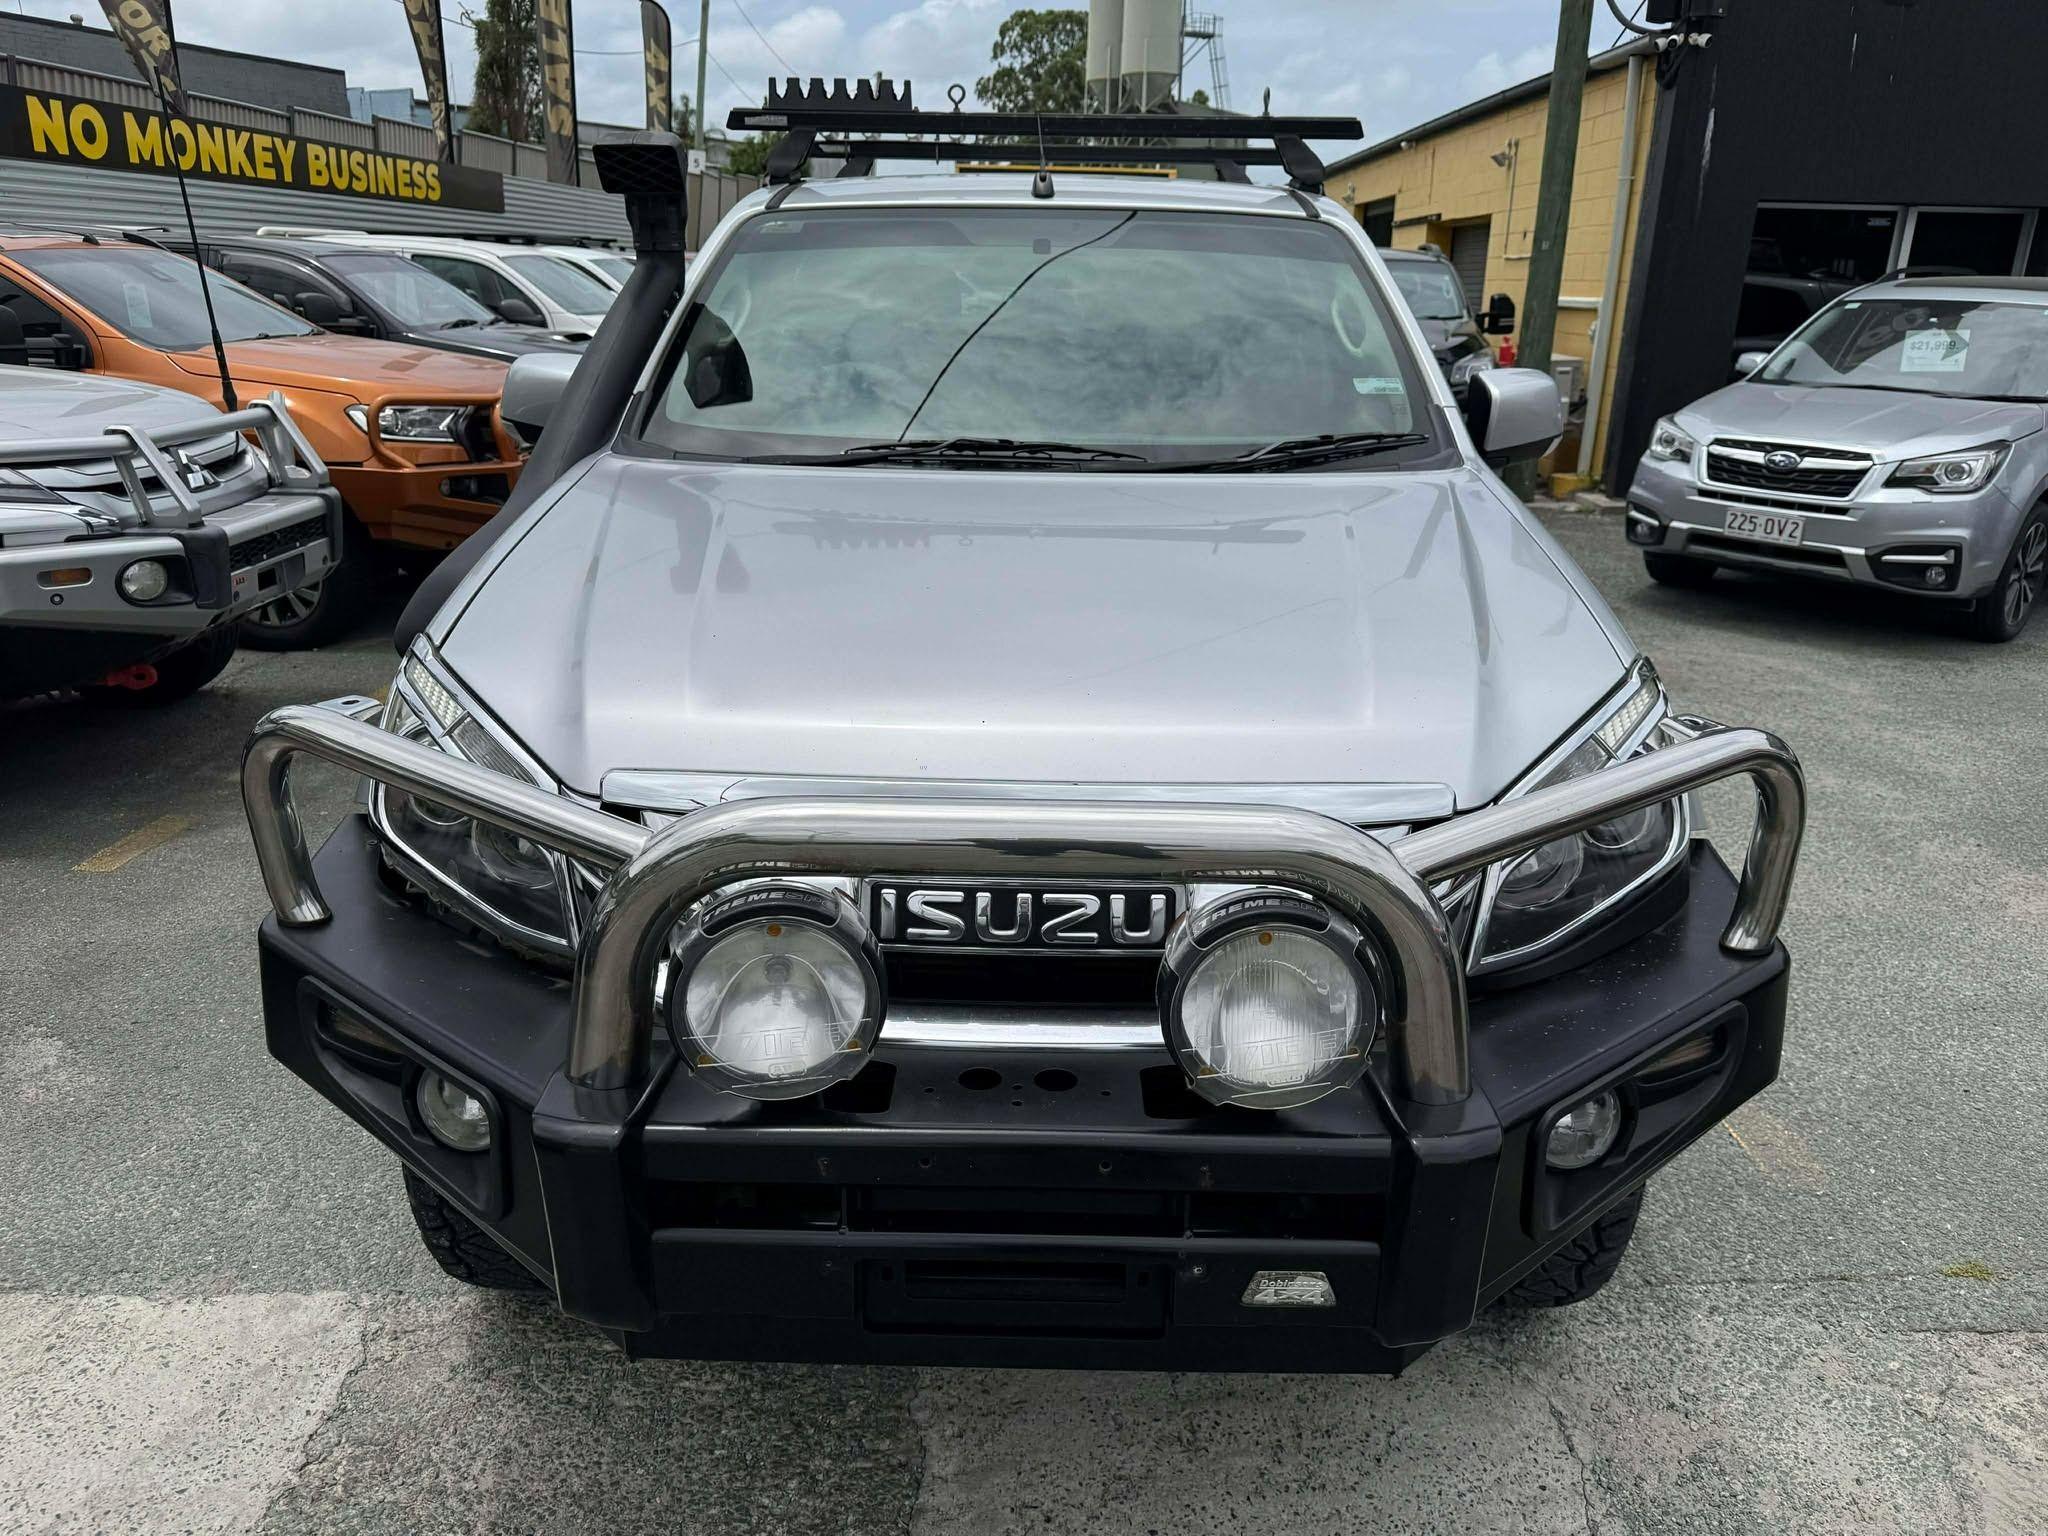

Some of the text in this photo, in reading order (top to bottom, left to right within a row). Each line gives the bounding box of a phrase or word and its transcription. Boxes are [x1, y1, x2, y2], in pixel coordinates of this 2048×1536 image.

[26, 95, 441, 200] NO MONKEY BUSINESS
[880, 888, 1167, 944] ISUZU
